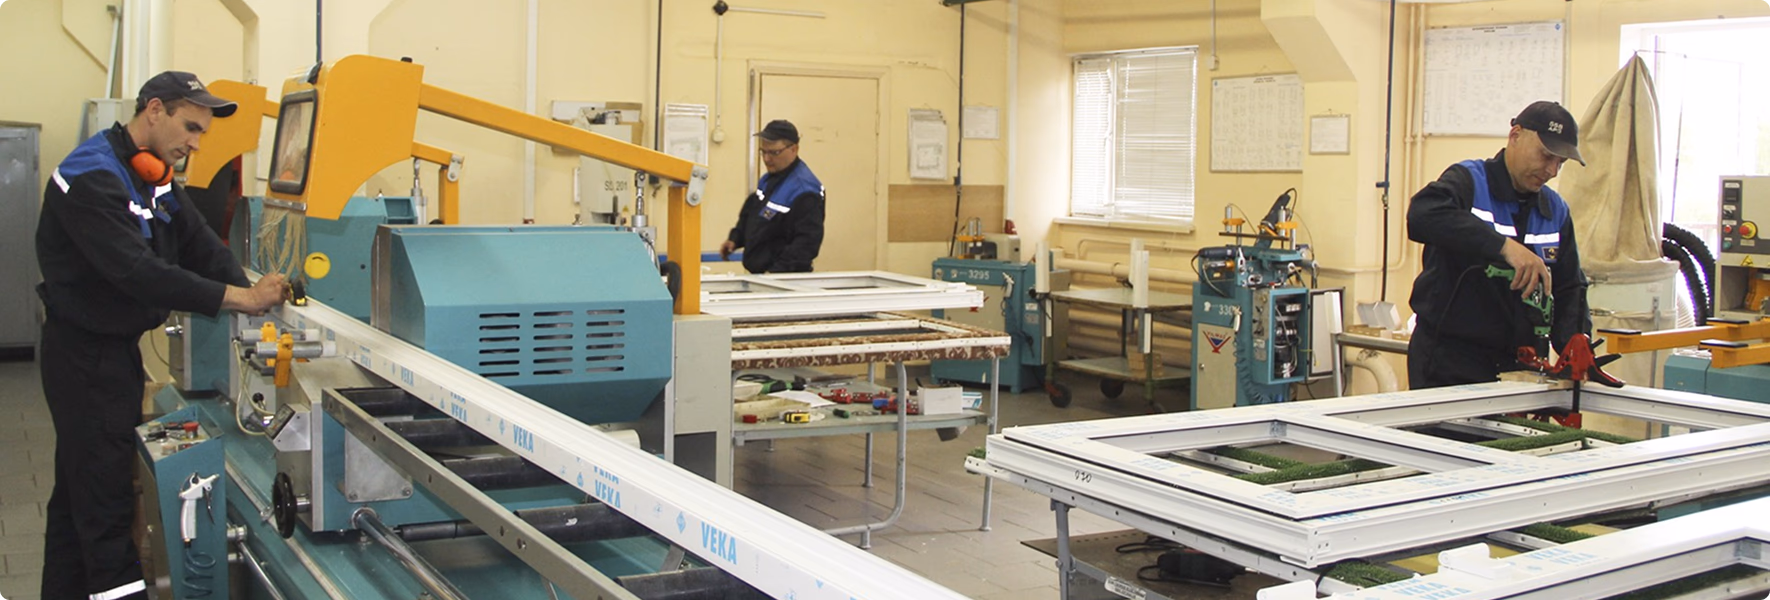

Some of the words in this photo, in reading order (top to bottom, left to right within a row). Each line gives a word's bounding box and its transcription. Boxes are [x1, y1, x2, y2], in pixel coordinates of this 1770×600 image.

[968, 269, 990, 280] 3295
[513, 423, 534, 453] VEKA
[594, 479, 621, 509] VEKA
[701, 521, 738, 565] VEKA
